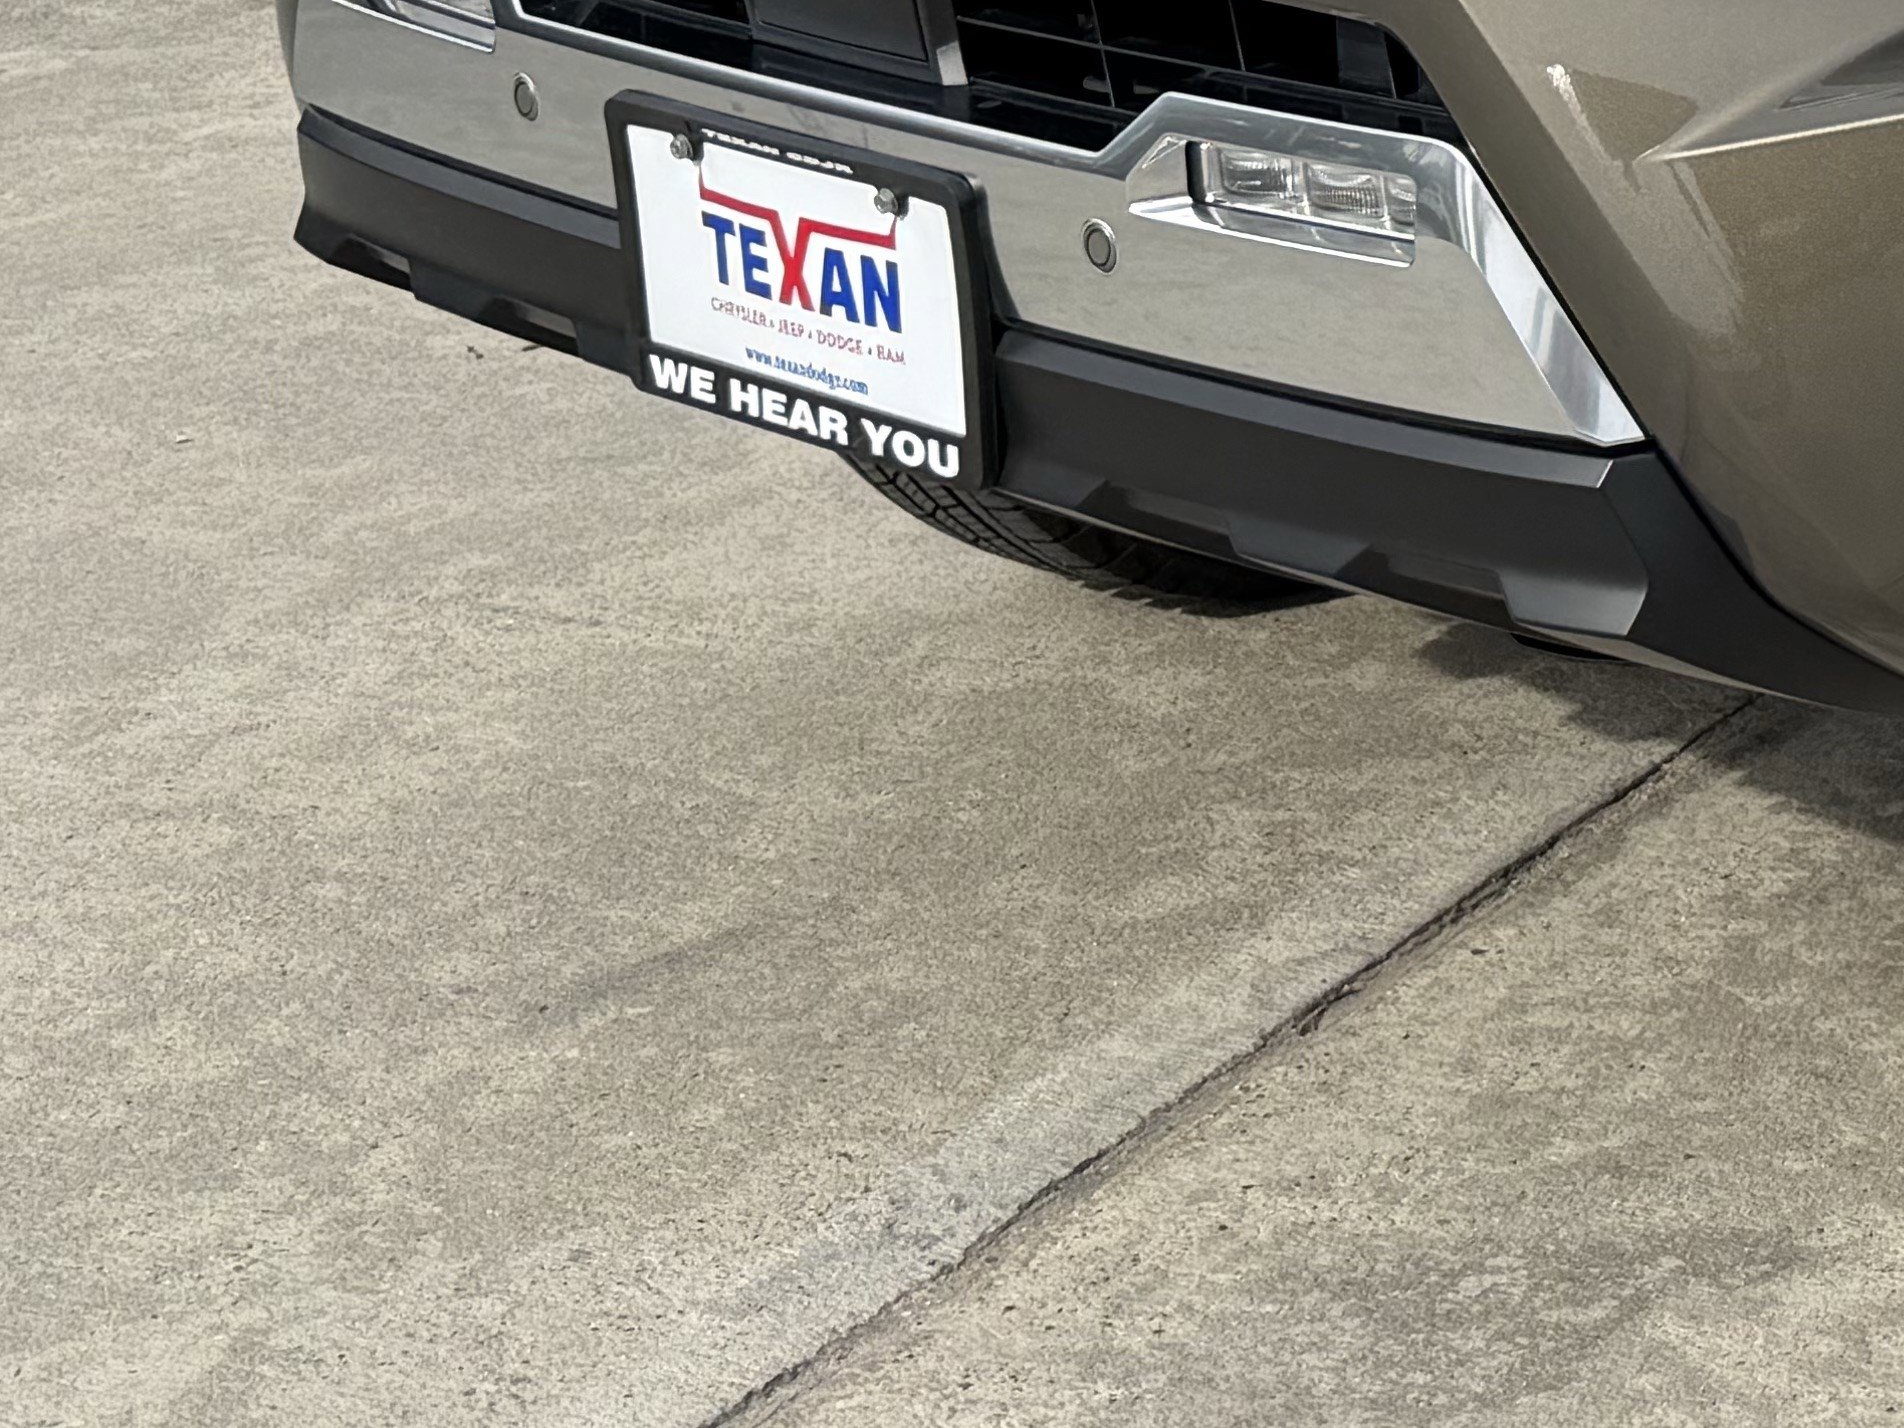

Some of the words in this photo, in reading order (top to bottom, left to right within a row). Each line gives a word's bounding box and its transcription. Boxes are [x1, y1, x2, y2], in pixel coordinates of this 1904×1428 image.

[700, 206, 903, 334] TEXAN
[816, 329, 863, 355] DODGE
[877, 344, 906, 365] RAM
[649, 353, 716, 404] WE
[729, 377, 849, 446] HEAR
[860, 418, 960, 478] YOU
